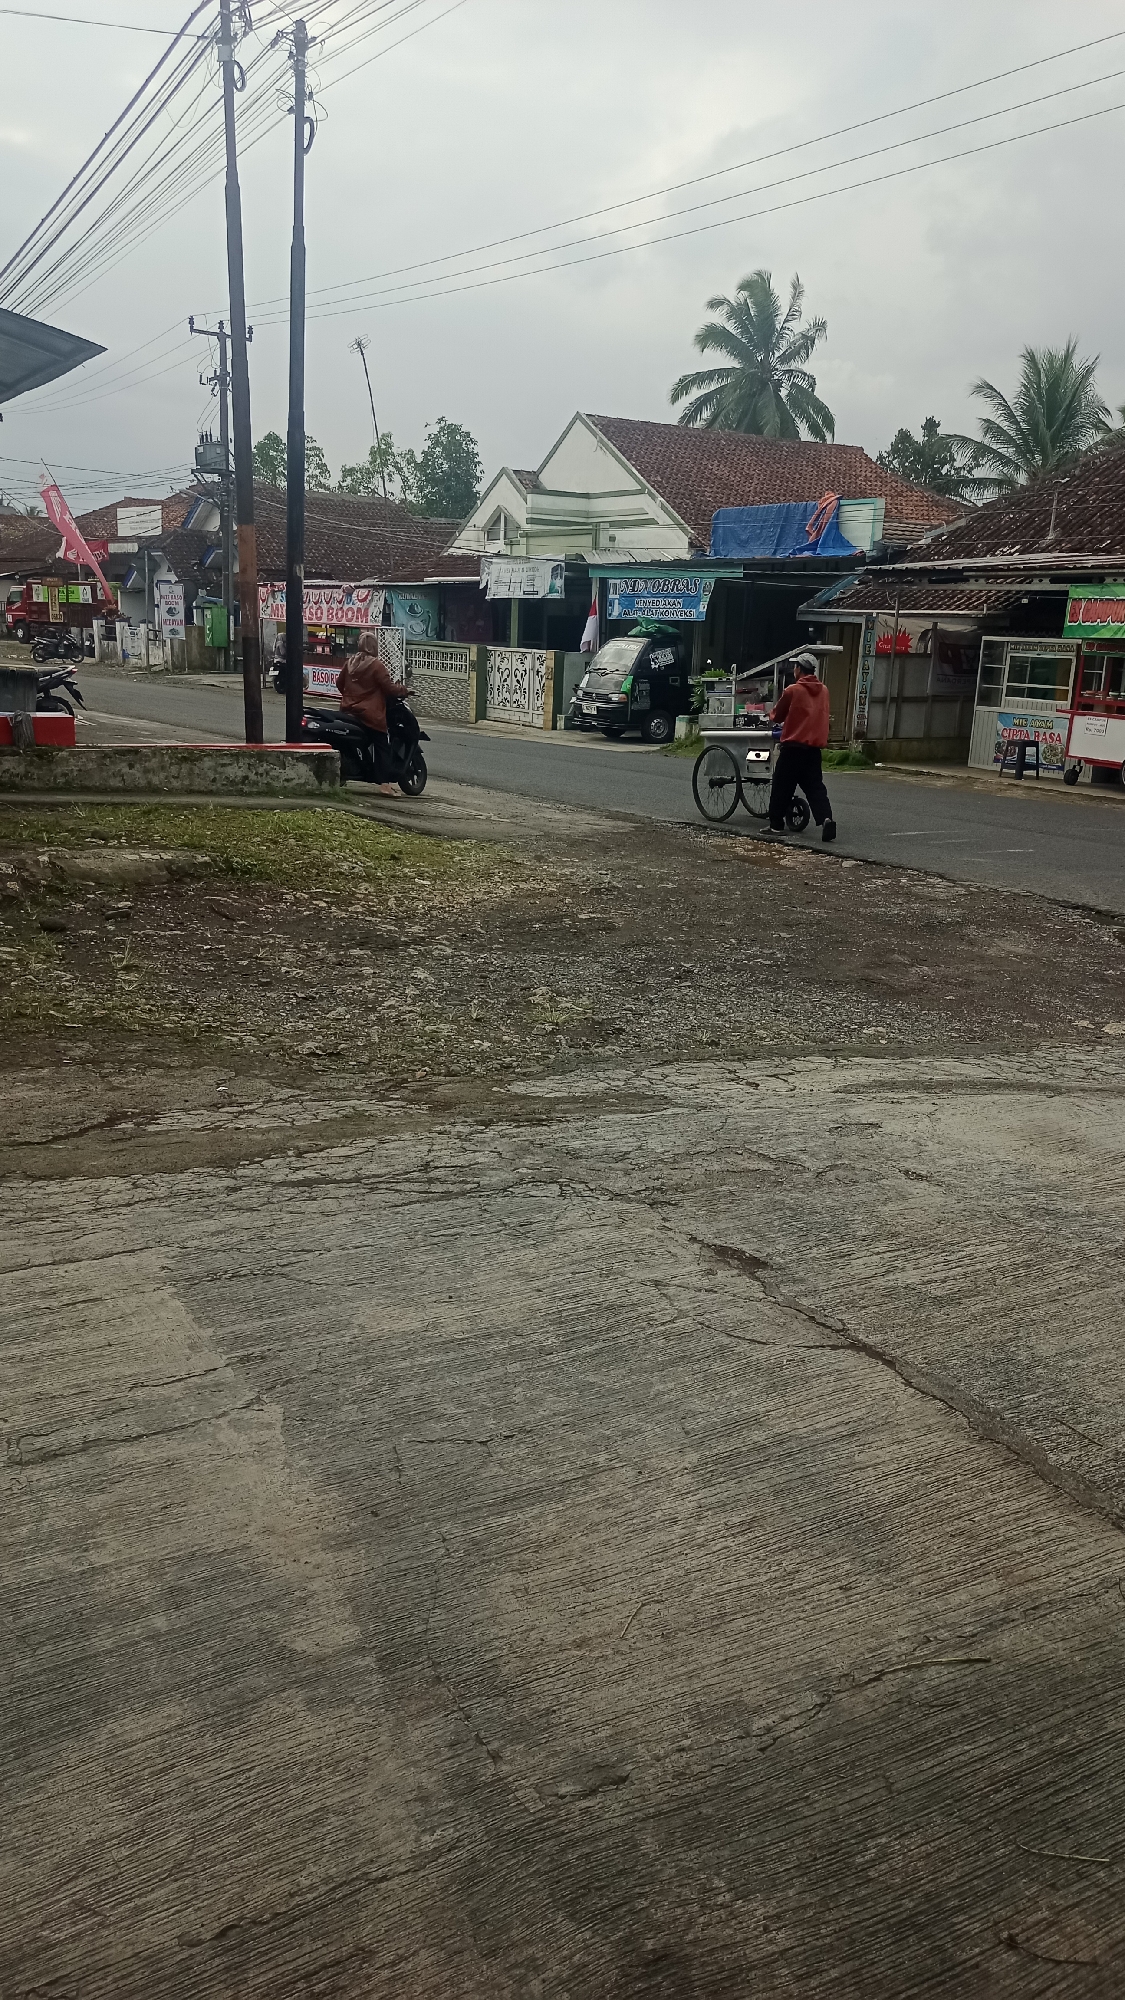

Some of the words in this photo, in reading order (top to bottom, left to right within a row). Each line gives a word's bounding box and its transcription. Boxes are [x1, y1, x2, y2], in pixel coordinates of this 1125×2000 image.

[651, 578, 700, 594] OBRAS
[326, 606, 369, 623] BOOM
[659, 609, 695, 618] KONVEKSI
[1067, 598, 1082, 625] ES
[312, 670, 329, 684] BASO
[1012, 717, 1028, 726] MIE
[1001, 728, 1030, 741] CIPTA
[1033, 730, 1062, 744] RASA
